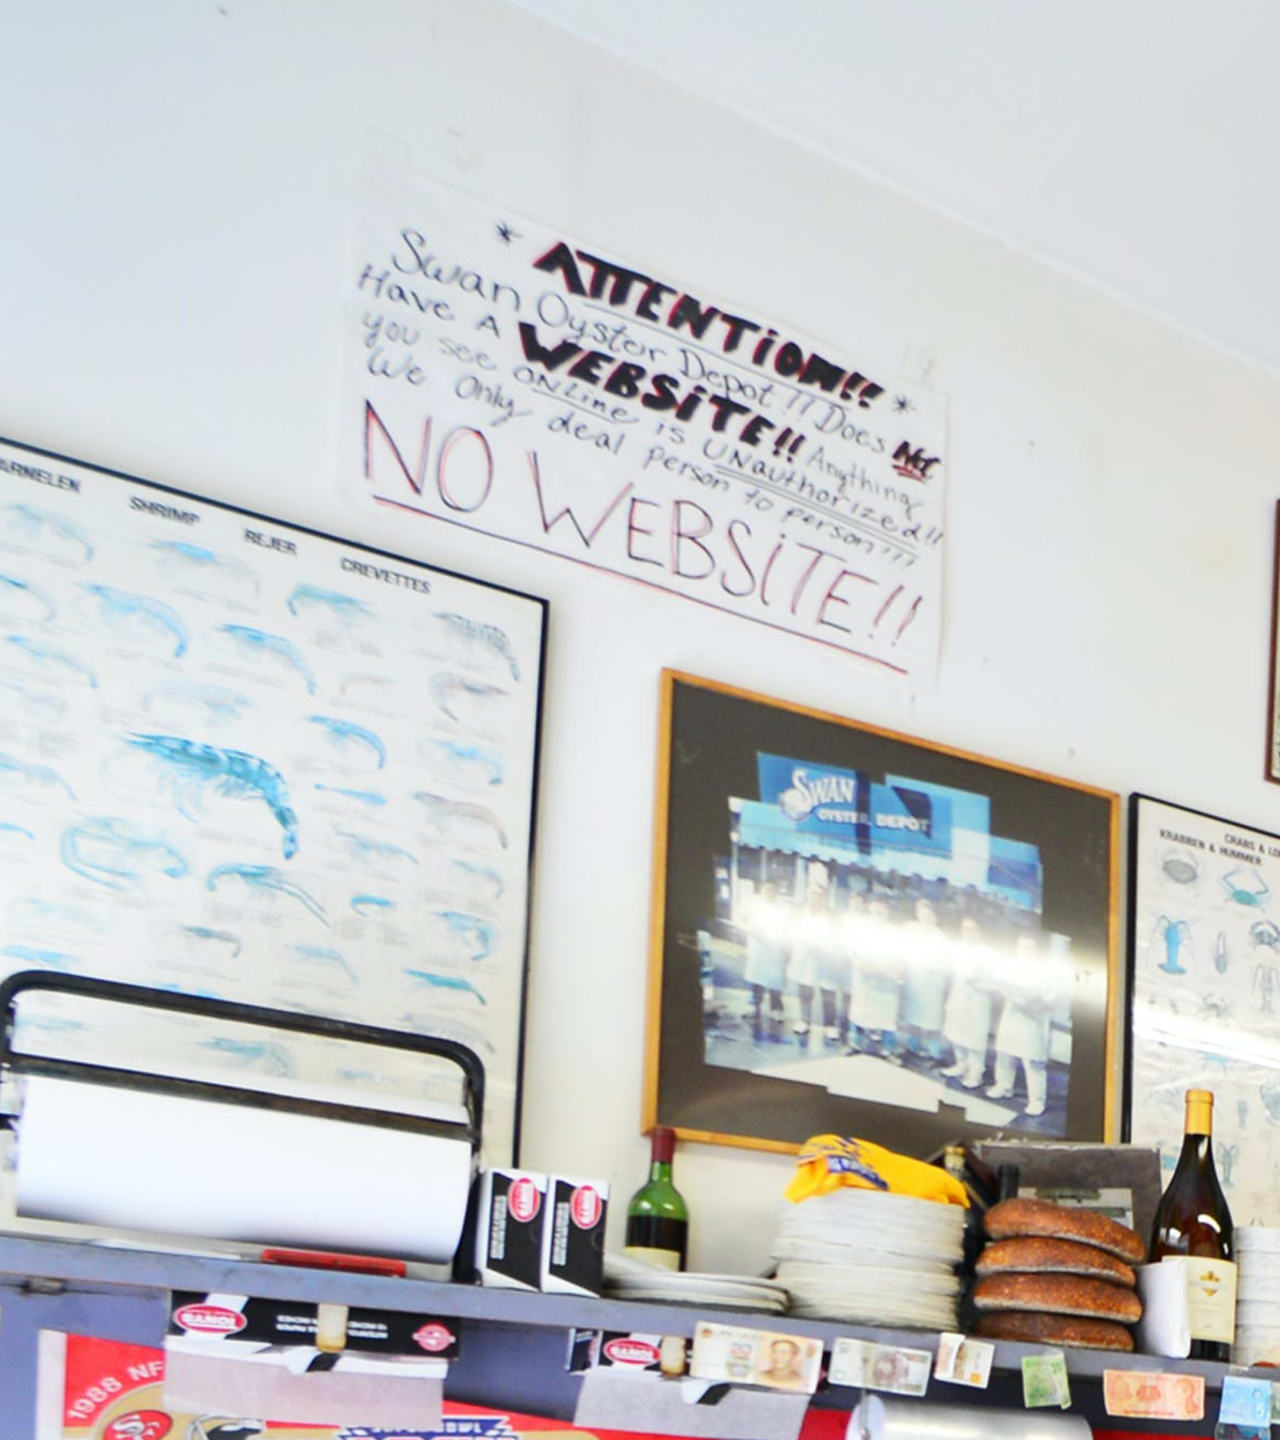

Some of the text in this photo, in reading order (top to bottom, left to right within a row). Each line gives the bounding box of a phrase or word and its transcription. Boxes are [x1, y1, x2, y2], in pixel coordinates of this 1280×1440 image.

[359, 265, 455, 322] Have
[475, 313, 502, 338] A
[807, 447, 924, 521] Anything
[360, 310, 420, 348] you
[439, 337, 499, 372] see
[655, 417, 687, 449] is
[390, 227, 522, 312] Swan
[537, 292, 666, 362] Oyster
[815, 406, 886, 454] Does
[0, 458, 82, 494] ARNELEN
[364, 398, 495, 514] NO
[366, 346, 427, 387] We
[547, 409, 626, 455] deal
[642, 448, 733, 501] person
[741, 486, 775, 514] to
[128, 497, 201, 526] SHRIMP
[339, 558, 433, 595] CREVETTES
[68, 1361, 166, 1420] 1988 NF
